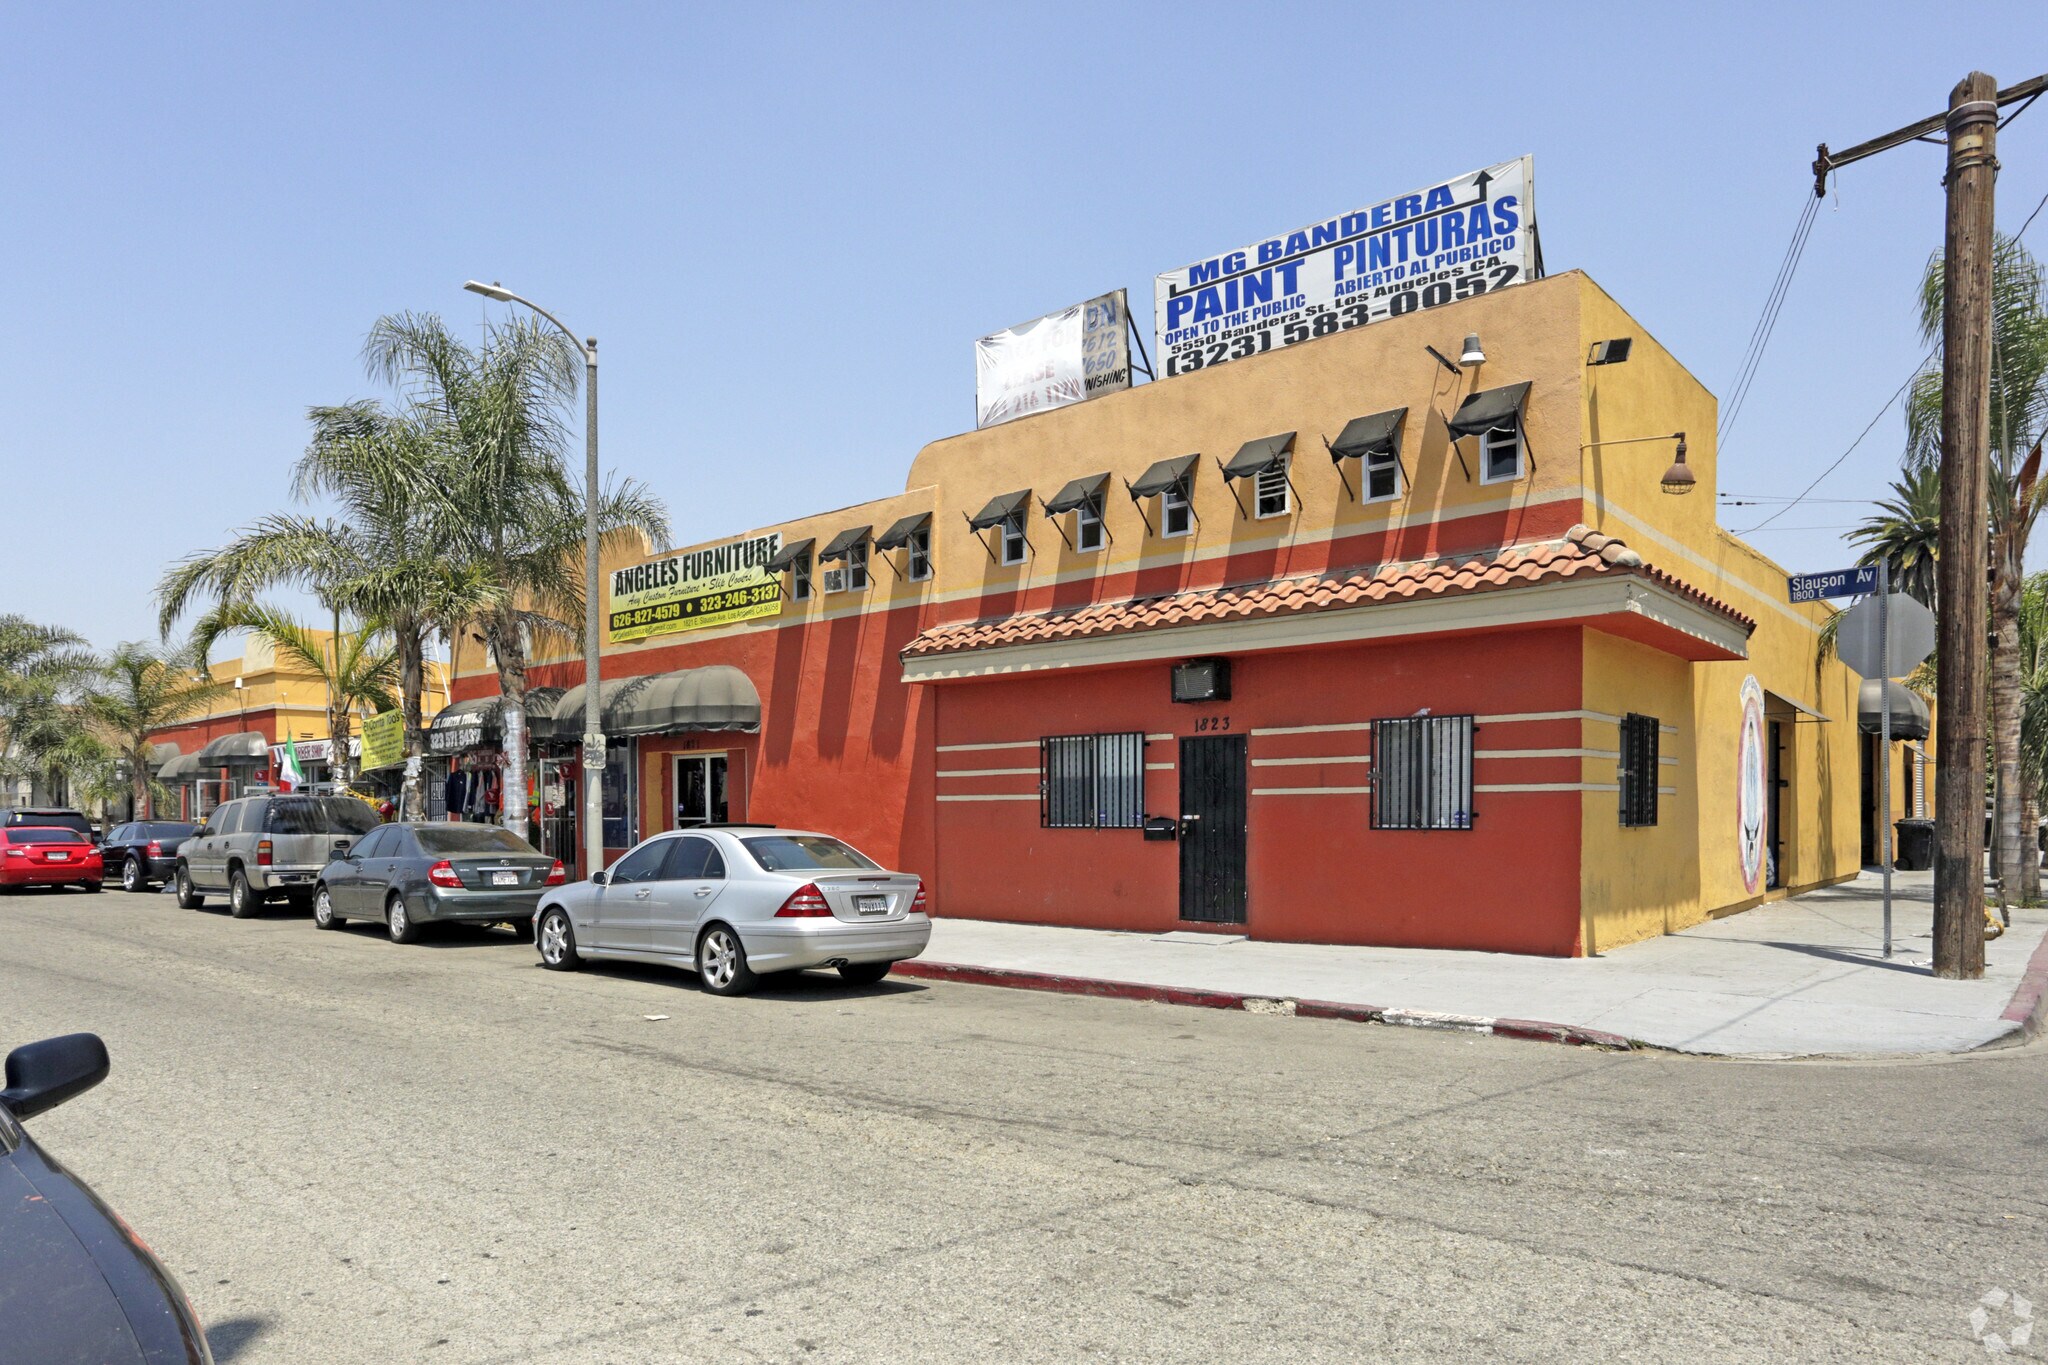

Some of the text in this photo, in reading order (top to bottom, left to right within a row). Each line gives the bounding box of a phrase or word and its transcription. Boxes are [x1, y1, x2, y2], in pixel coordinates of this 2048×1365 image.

[1189, 184, 1455, 287] MG BANDERA
[1166, 195, 1519, 331] PAINT PINTURAS
[1334, 235, 1516, 298] ABIERTO AL PUBLICO
[1165, 293, 1306, 346] OPEN TO THE PUBLIC
[1171, 256, 1507, 354] 5550 Bandera St. Los Angeles CA.
[1283, 264, 1520, 345] 583-0052
[615, 533, 778, 597] ANGELES FURNITURE
[1792, 570, 1873, 592] Slauson Av
[613, 584, 779, 628] 626-827-4579 323-246-3137
[643, 591, 666, 605] Custom
[668, 585, 700, 600] Furniture
[1793, 588, 1825, 601] 1800 E
[430, 732, 444, 750] 323
[1194, 716, 1230, 732] 1823
